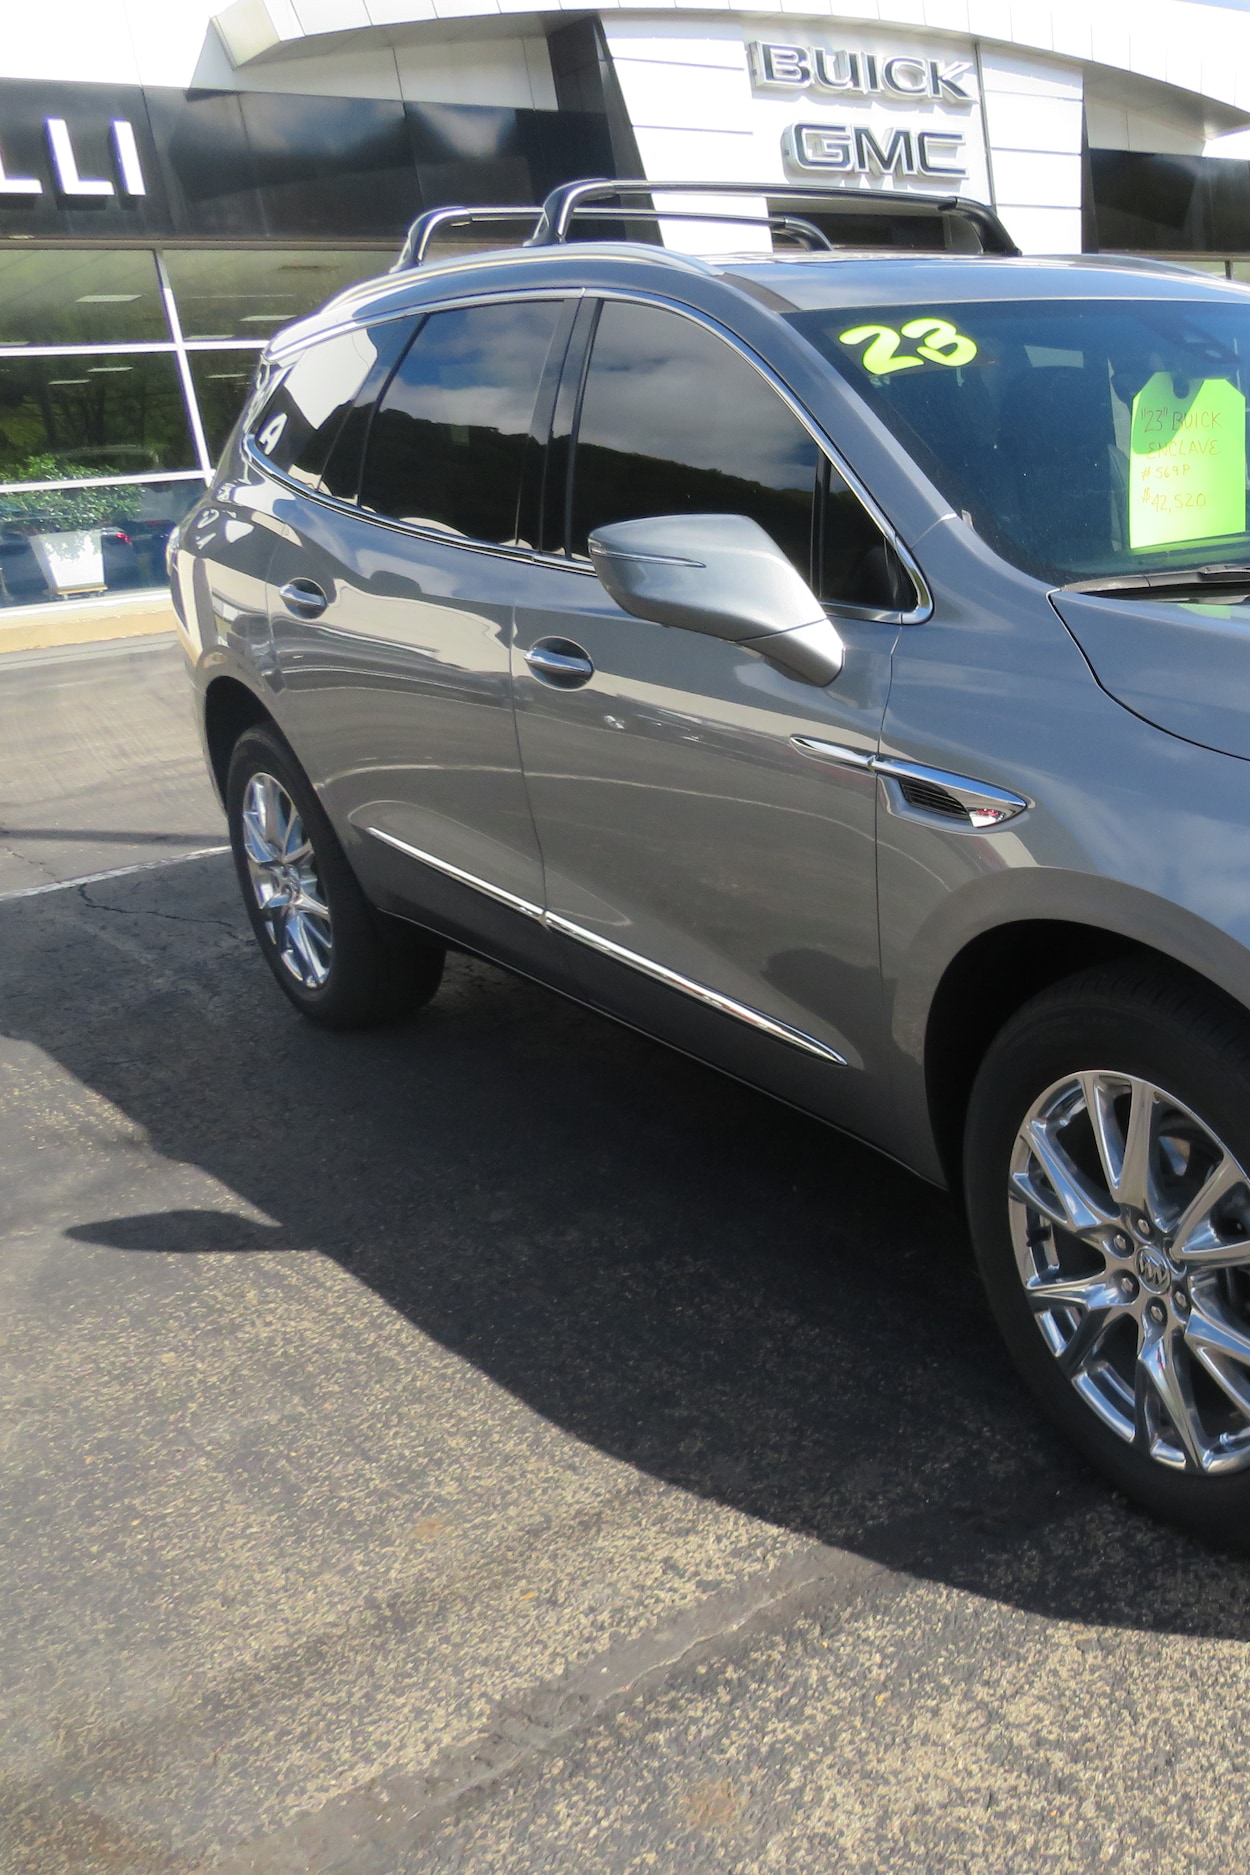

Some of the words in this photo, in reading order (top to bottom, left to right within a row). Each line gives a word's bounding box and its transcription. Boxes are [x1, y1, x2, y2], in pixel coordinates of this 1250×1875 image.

[750, 40, 978, 104] BUICK
[781, 121, 970, 180] GMC
[838, 317, 979, 375] 23
[1146, 439, 1221, 459] ENCLAVE
[1172, 411, 1222, 431] BUICK
